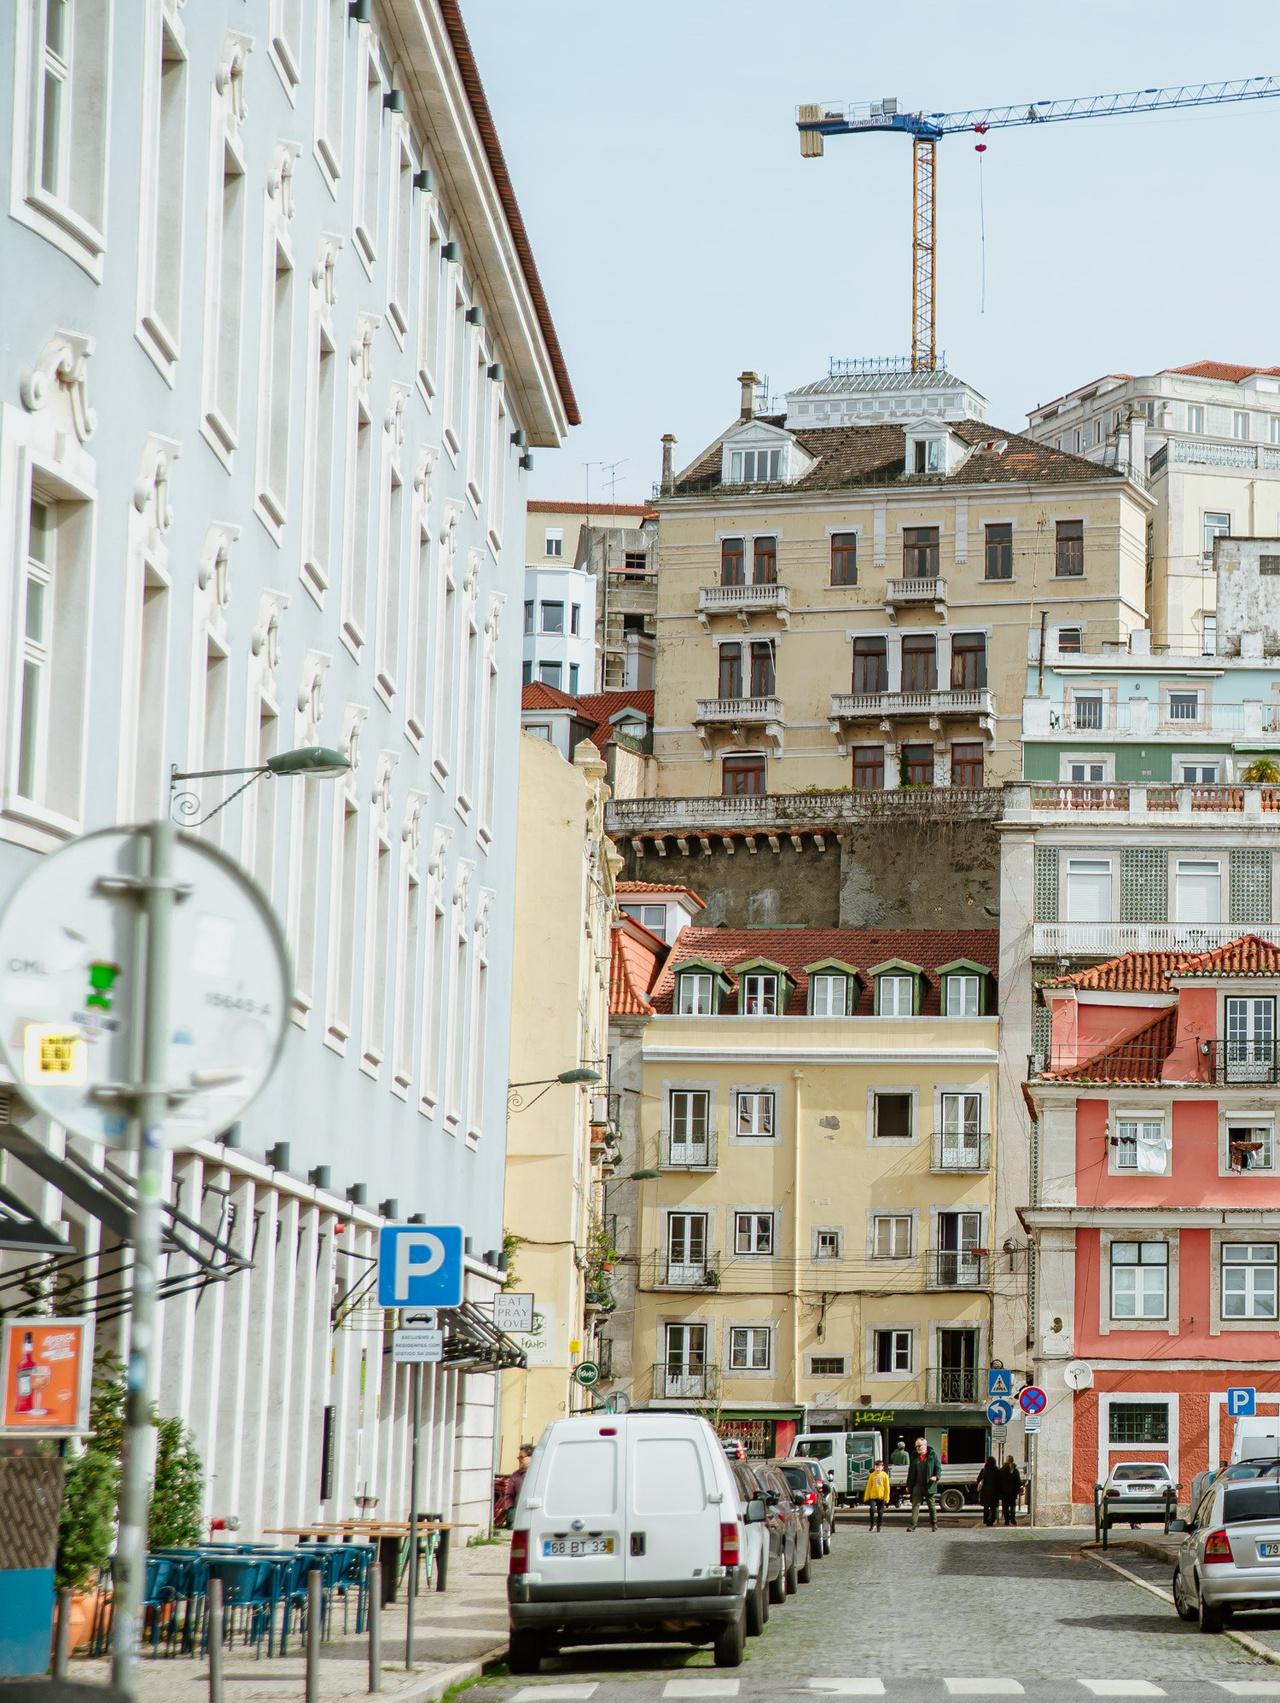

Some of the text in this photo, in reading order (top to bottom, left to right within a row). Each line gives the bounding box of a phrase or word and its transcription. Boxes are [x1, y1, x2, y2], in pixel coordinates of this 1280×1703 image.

[849, 117, 892, 127] MUNDIGRUAS
[394, 1232, 445, 1301] P
[498, 1297, 522, 1306] EAT
[497, 1308, 530, 1317] PRAY
[498, 1319, 529, 1329] LOVE
[1069, 1367, 1085, 1376] NOS
[1233, 1390, 1250, 1414] P
